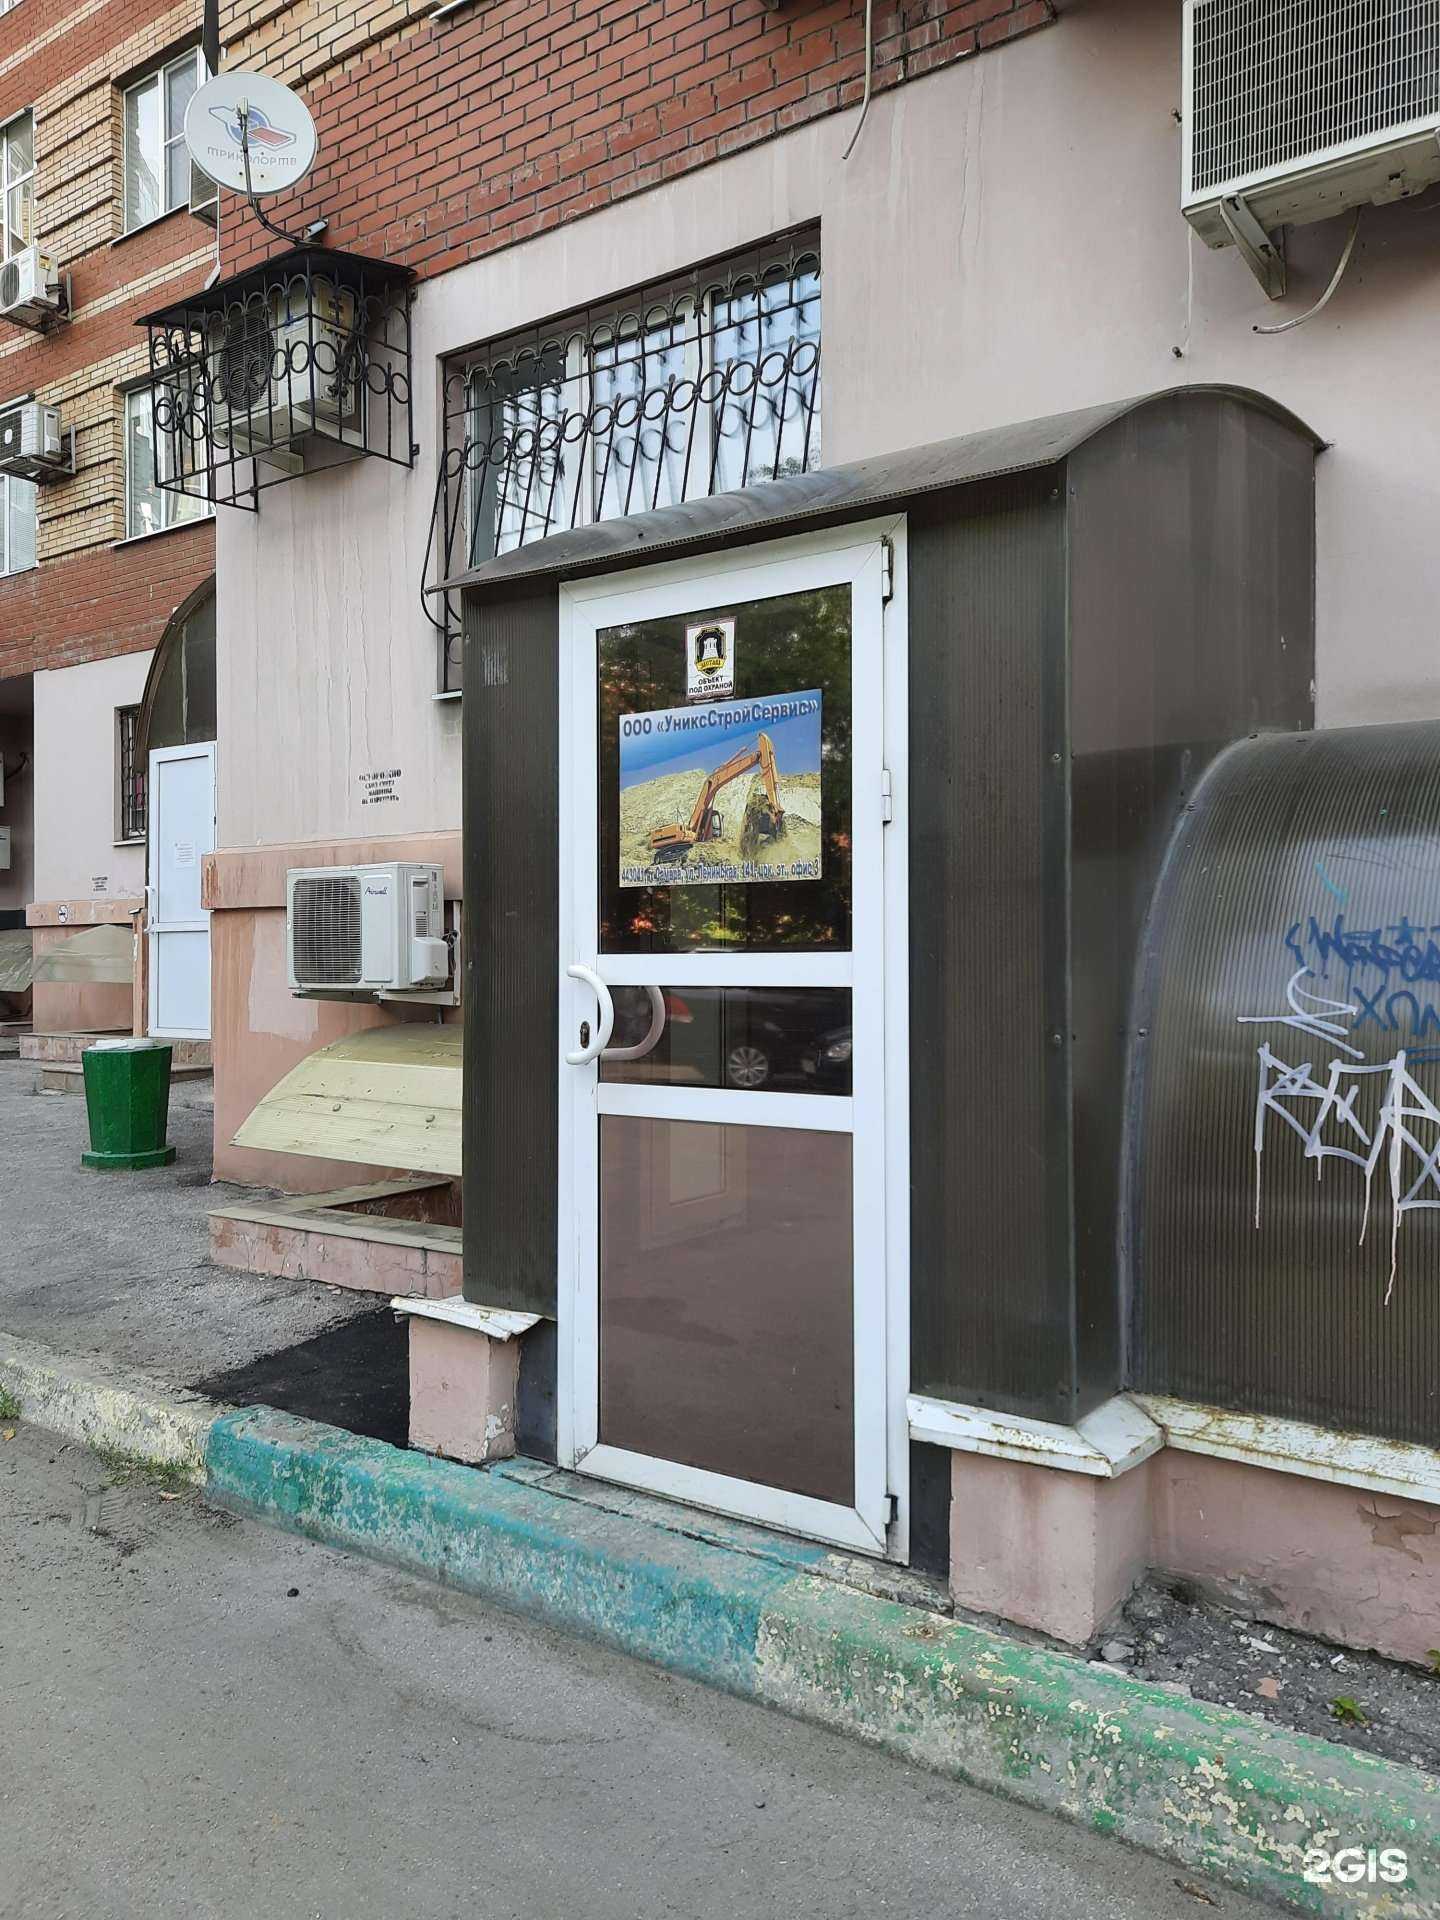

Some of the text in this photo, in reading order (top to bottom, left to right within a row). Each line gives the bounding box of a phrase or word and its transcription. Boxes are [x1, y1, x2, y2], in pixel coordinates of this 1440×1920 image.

[689, 680, 733, 694] ПОД ОХРАНОЙ
[698, 675, 724, 686] ОБЪЕКТ
[623, 700, 818, 737] ООО «УниксСтройСервис»
